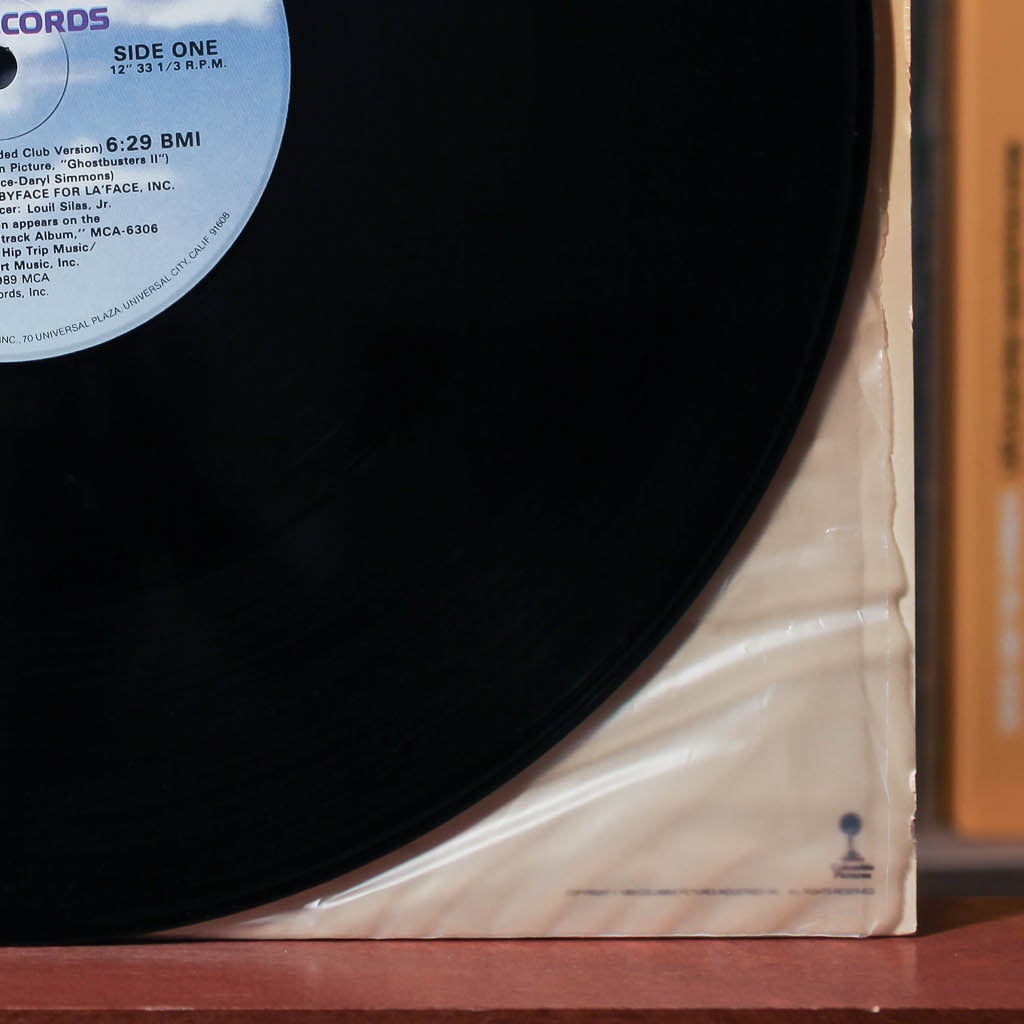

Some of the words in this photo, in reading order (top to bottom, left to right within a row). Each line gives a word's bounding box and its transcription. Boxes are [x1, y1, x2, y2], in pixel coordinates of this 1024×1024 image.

[113, 42, 164, 62] SIDE
[172, 39, 219, 58] ONE
[137, 62, 153, 74] 33
[157, 61, 181, 72] 1/3
[185, 58, 227, 70] R.P.M.
[22, 147, 50, 158] Club
[54, 143, 103, 156] Version)
[106, 134, 152, 153] 6:29
[161, 131, 201, 149] BMI
[10, 161, 55, 174] Picture,
[60, 154, 146, 169] "Ghostbusters
[54, 170, 114, 184] Simmons)
[54, 186, 80, 197] FOR
[148, 180, 175, 191] INC.
[27, 202, 55, 214] Louil
[59, 200, 91, 212] Silas,
[96, 199, 112, 209] Jr.
[12, 219, 59, 231] appears
[62, 216, 76, 226] on
[81, 214, 100, 224] the
[90, 223, 159, 238] MCA-6306
[2, 247, 22, 259] Hip
[26, 245, 49, 257] Trip
[53, 242, 96, 254] Music/
[14, 259, 53, 271] Music,
[58, 257, 80, 268] Inc.
[22, 272, 50, 284] MCA
[23, 334, 34, 343] 70
[35, 320, 90, 342] UNIVERSAL
[122, 275, 172, 311] UNIVERSAL
[209, 211, 231, 236] 91608
[29, 287, 49, 297] Inc.
